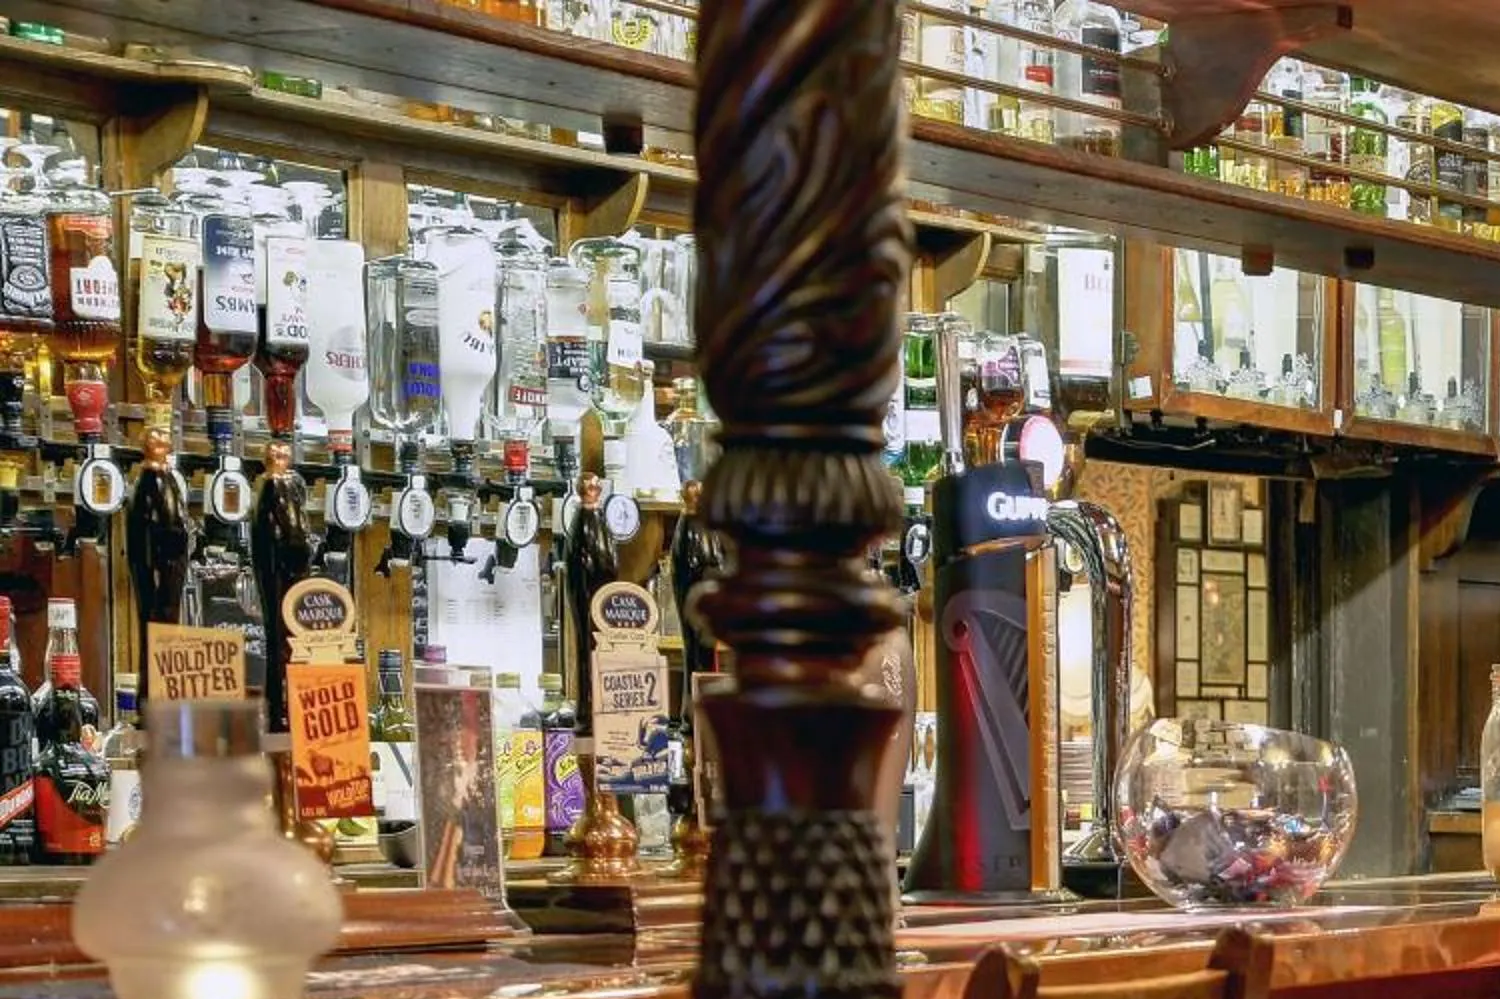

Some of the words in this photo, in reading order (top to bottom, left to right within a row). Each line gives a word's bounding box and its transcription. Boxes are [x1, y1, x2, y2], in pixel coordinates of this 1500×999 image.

[214, 295, 256, 315] AMB'S
[154, 647, 206, 677] WOLD
[201, 639, 239, 669] TOP
[164, 666, 238, 701] BITTER
[298, 680, 356, 711] WOLD
[603, 673, 645, 692] COASTAL
[644, 671, 657, 707] 2
[613, 690, 645, 709] SERIES
[303, 700, 360, 741] GOLD
